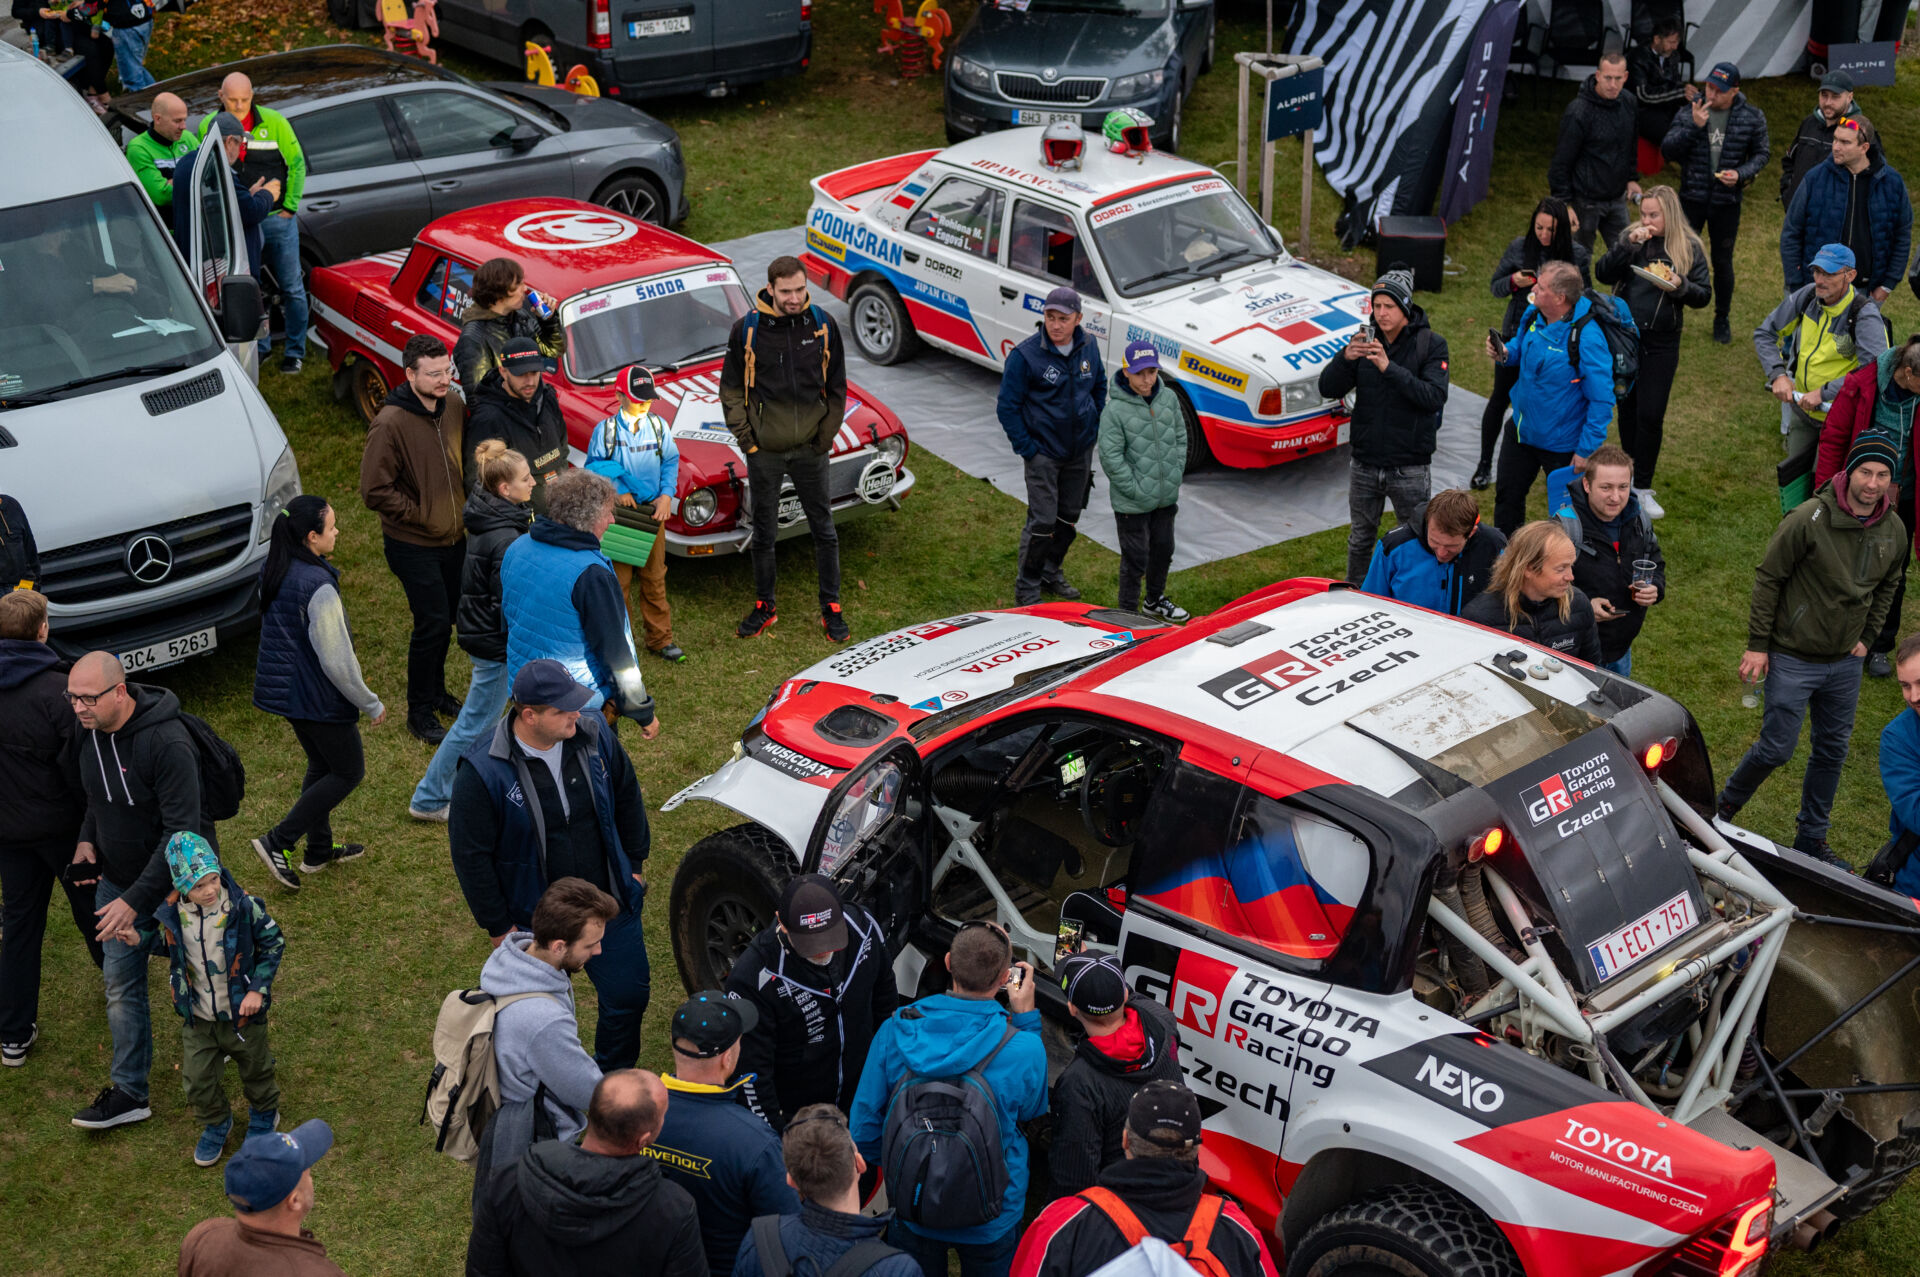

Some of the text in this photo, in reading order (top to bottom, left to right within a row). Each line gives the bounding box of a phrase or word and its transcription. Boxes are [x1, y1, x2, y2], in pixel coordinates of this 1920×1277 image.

[636, 18, 686, 34] 7H6 1024
[1839, 60, 1886, 70] ALPINE
[1276, 91, 1317, 111] ALPINE
[1457, 41, 1493, 183] ALPINE
[1021, 112, 1041, 124] 6H3
[971, 159, 1019, 178] JIPAM
[1018, 172, 1053, 187] CNC
[808, 232, 843, 256] Barum
[812, 207, 904, 268] PODHORAN
[964, 238, 972, 251] L.
[972, 228, 983, 240] M.
[636, 278, 686, 301] ŠKODA
[914, 281, 958, 306] JIPAM CNC
[1244, 292, 1294, 312] stavis
[1086, 322, 1107, 335] stavis
[1184, 356, 1244, 388] Barum
[1271, 432, 1323, 450] JIPAM CNC
[866, 476, 893, 492] Hella
[1289, 610, 1390, 651] TOYOTA
[1306, 620, 1396, 660] GAZOO
[124, 649, 156, 671] 3C4
[168, 632, 210, 658] 5263
[838, 637, 912, 672] GAZOO
[839, 642, 923, 678] TOYOTA
[960, 638, 1060, 674] TOYOTA
[1320, 627, 1414, 668] Racing
[1222, 660, 1318, 706] GR
[1295, 648, 1421, 706] Czech
[762, 742, 834, 779] MUSICDATA
[770, 758, 787, 768] PLUG
[794, 767, 811, 778] PLAY
[1068, 760, 1078, 775] N
[1562, 752, 1610, 781] TOYOTA
[1568, 765, 1611, 792] GAZOO
[1572, 776, 1616, 804] Racing
[1528, 788, 1571, 823] GR
[1557, 800, 1615, 839] Czech
[1598, 966, 1606, 977] B
[1124, 964, 1218, 1035] GR
[1242, 972, 1382, 1039] TOYOTA
[1229, 999, 1352, 1057] GAZOO
[1224, 1022, 1336, 1090] Racing
[1415, 1054, 1505, 1113] NEXO
[1564, 1118, 1674, 1178] TOYOTA
[1549, 1151, 1704, 1216] MOTOR MANUFACTURING CZECH
